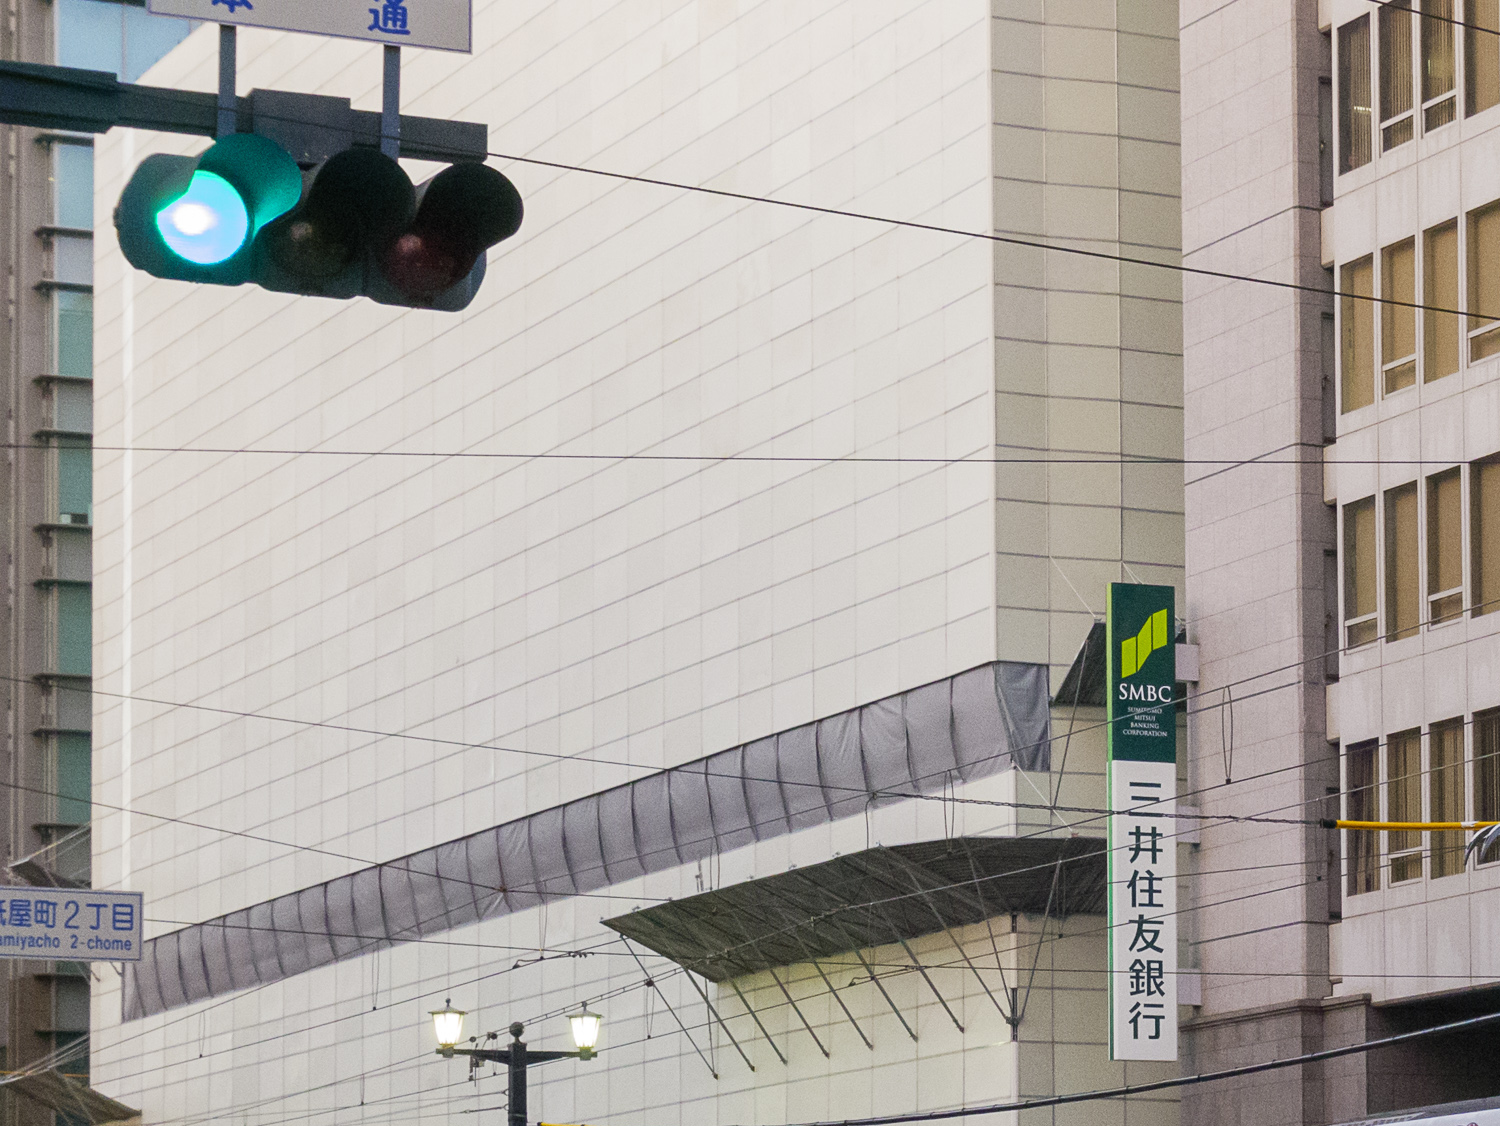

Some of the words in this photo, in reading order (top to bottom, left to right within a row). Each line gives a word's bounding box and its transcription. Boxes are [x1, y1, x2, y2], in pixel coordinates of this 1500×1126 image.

[1118, 683, 1172, 703] SMBC
[1134, 714, 1156, 722] MITSUI
[1130, 722, 1160, 730] BANKING
[1122, 729, 1168, 737] CORPORATION
[1127, 781, 1166, 1040] 三井住友銀行
[70, 934, 132, 950] 2-chome
